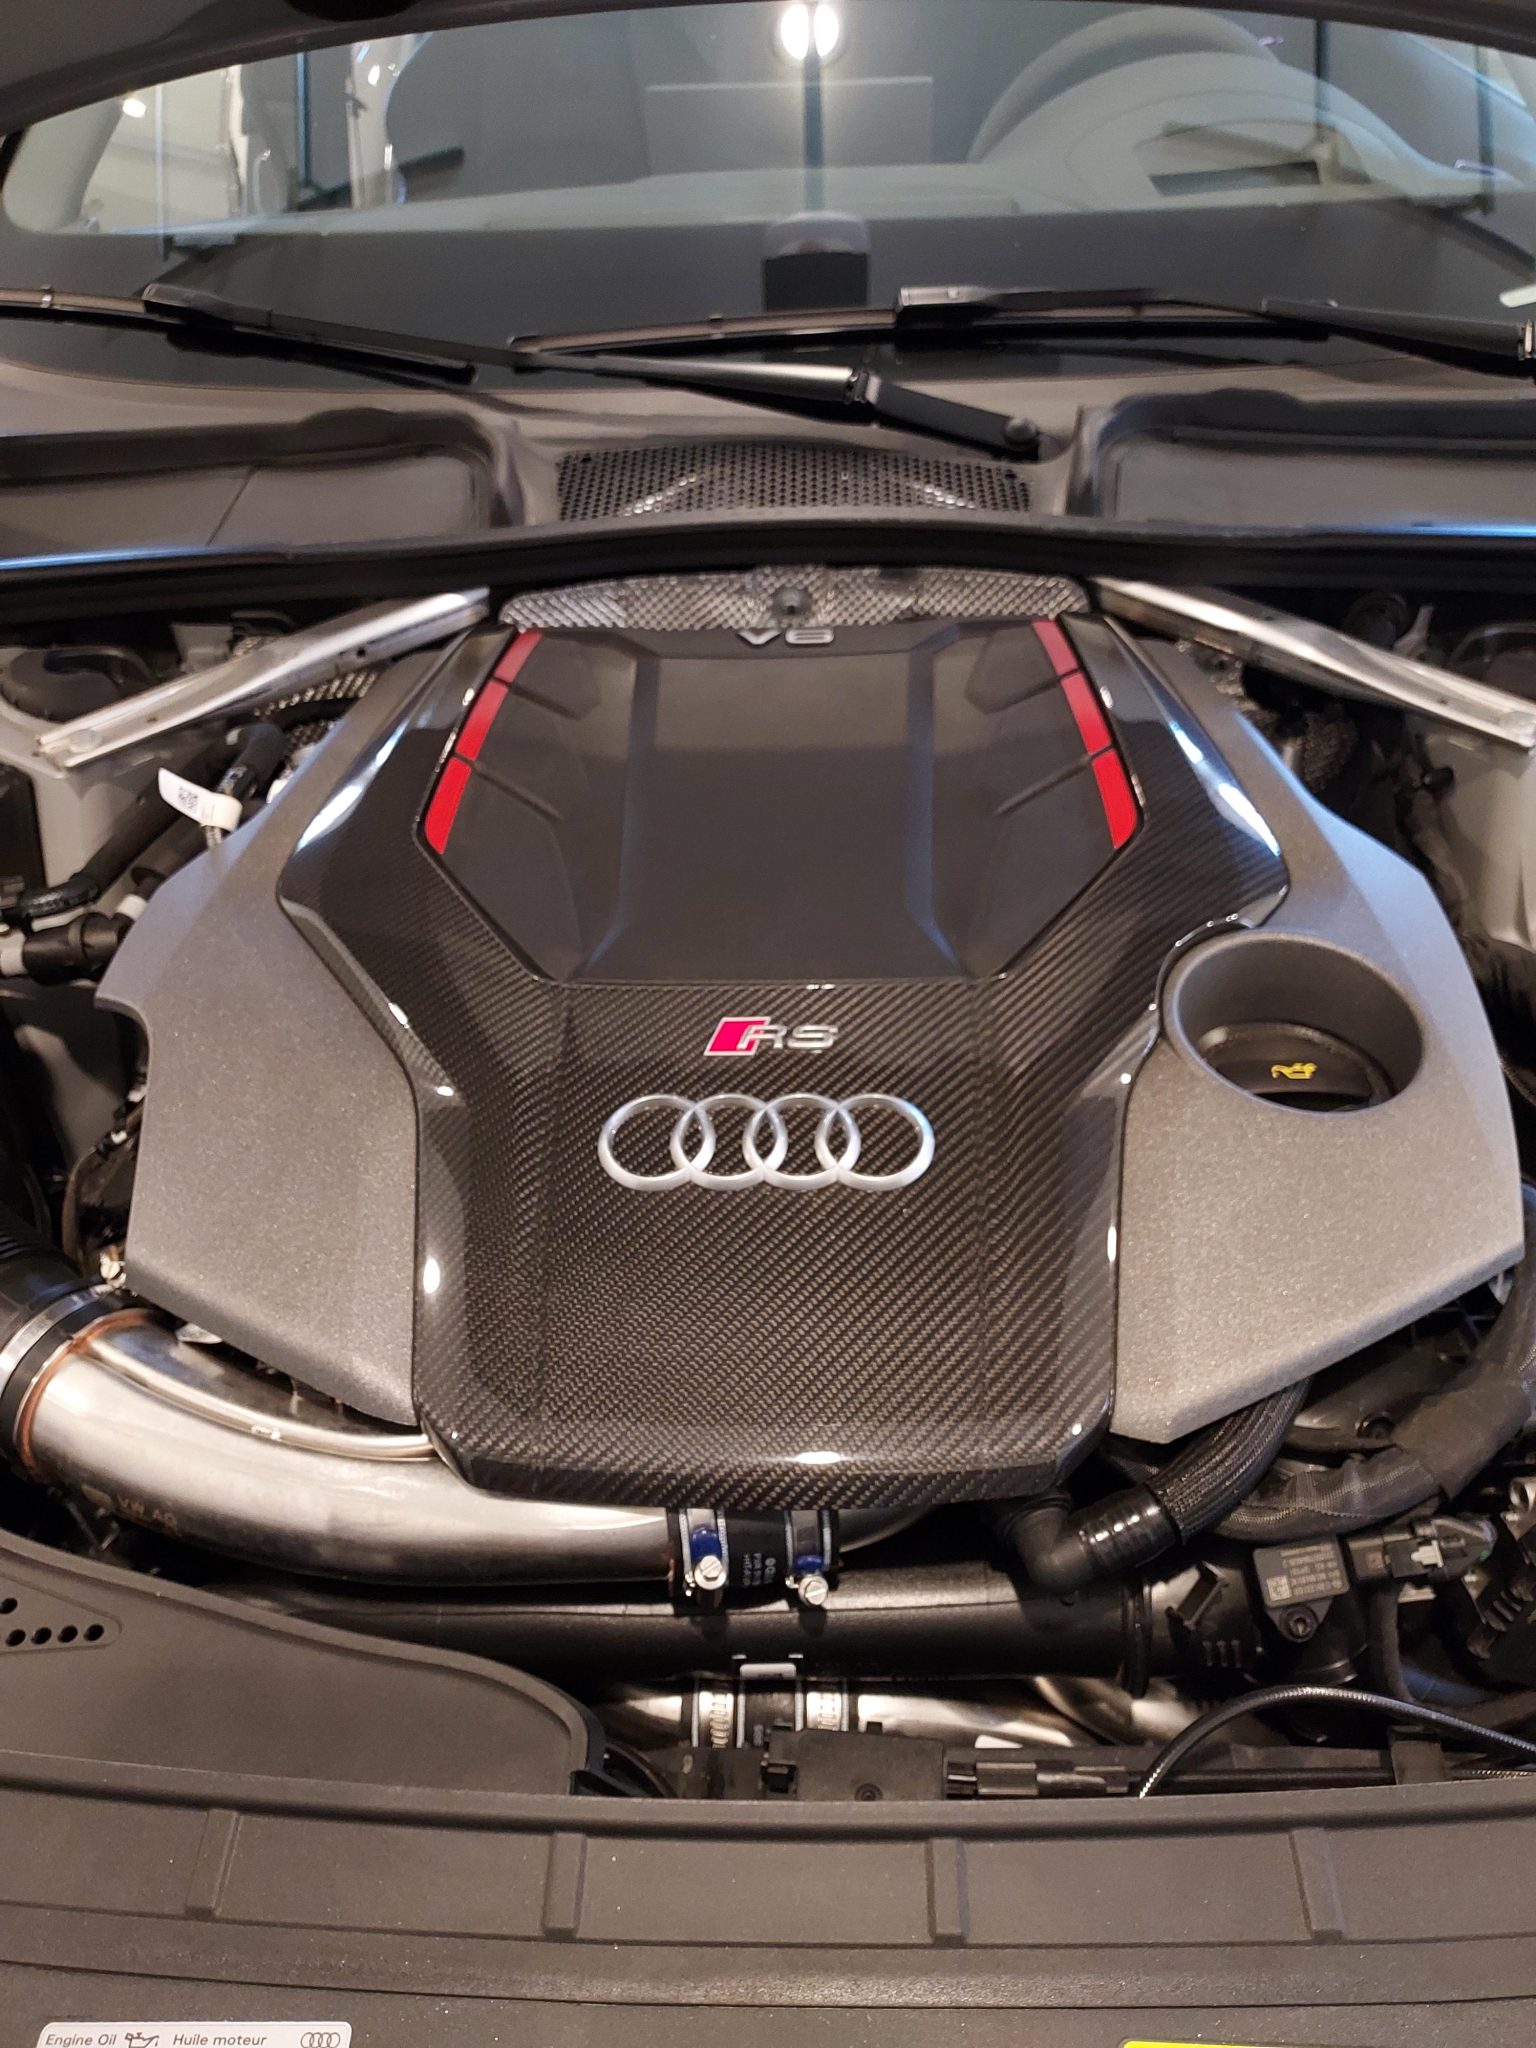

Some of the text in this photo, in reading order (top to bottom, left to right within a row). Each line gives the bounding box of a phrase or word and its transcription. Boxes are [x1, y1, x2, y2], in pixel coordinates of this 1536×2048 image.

[737, 1024, 839, 1050] RS
[45, 2034, 267, 2047] Engine Oil Huile moteur
